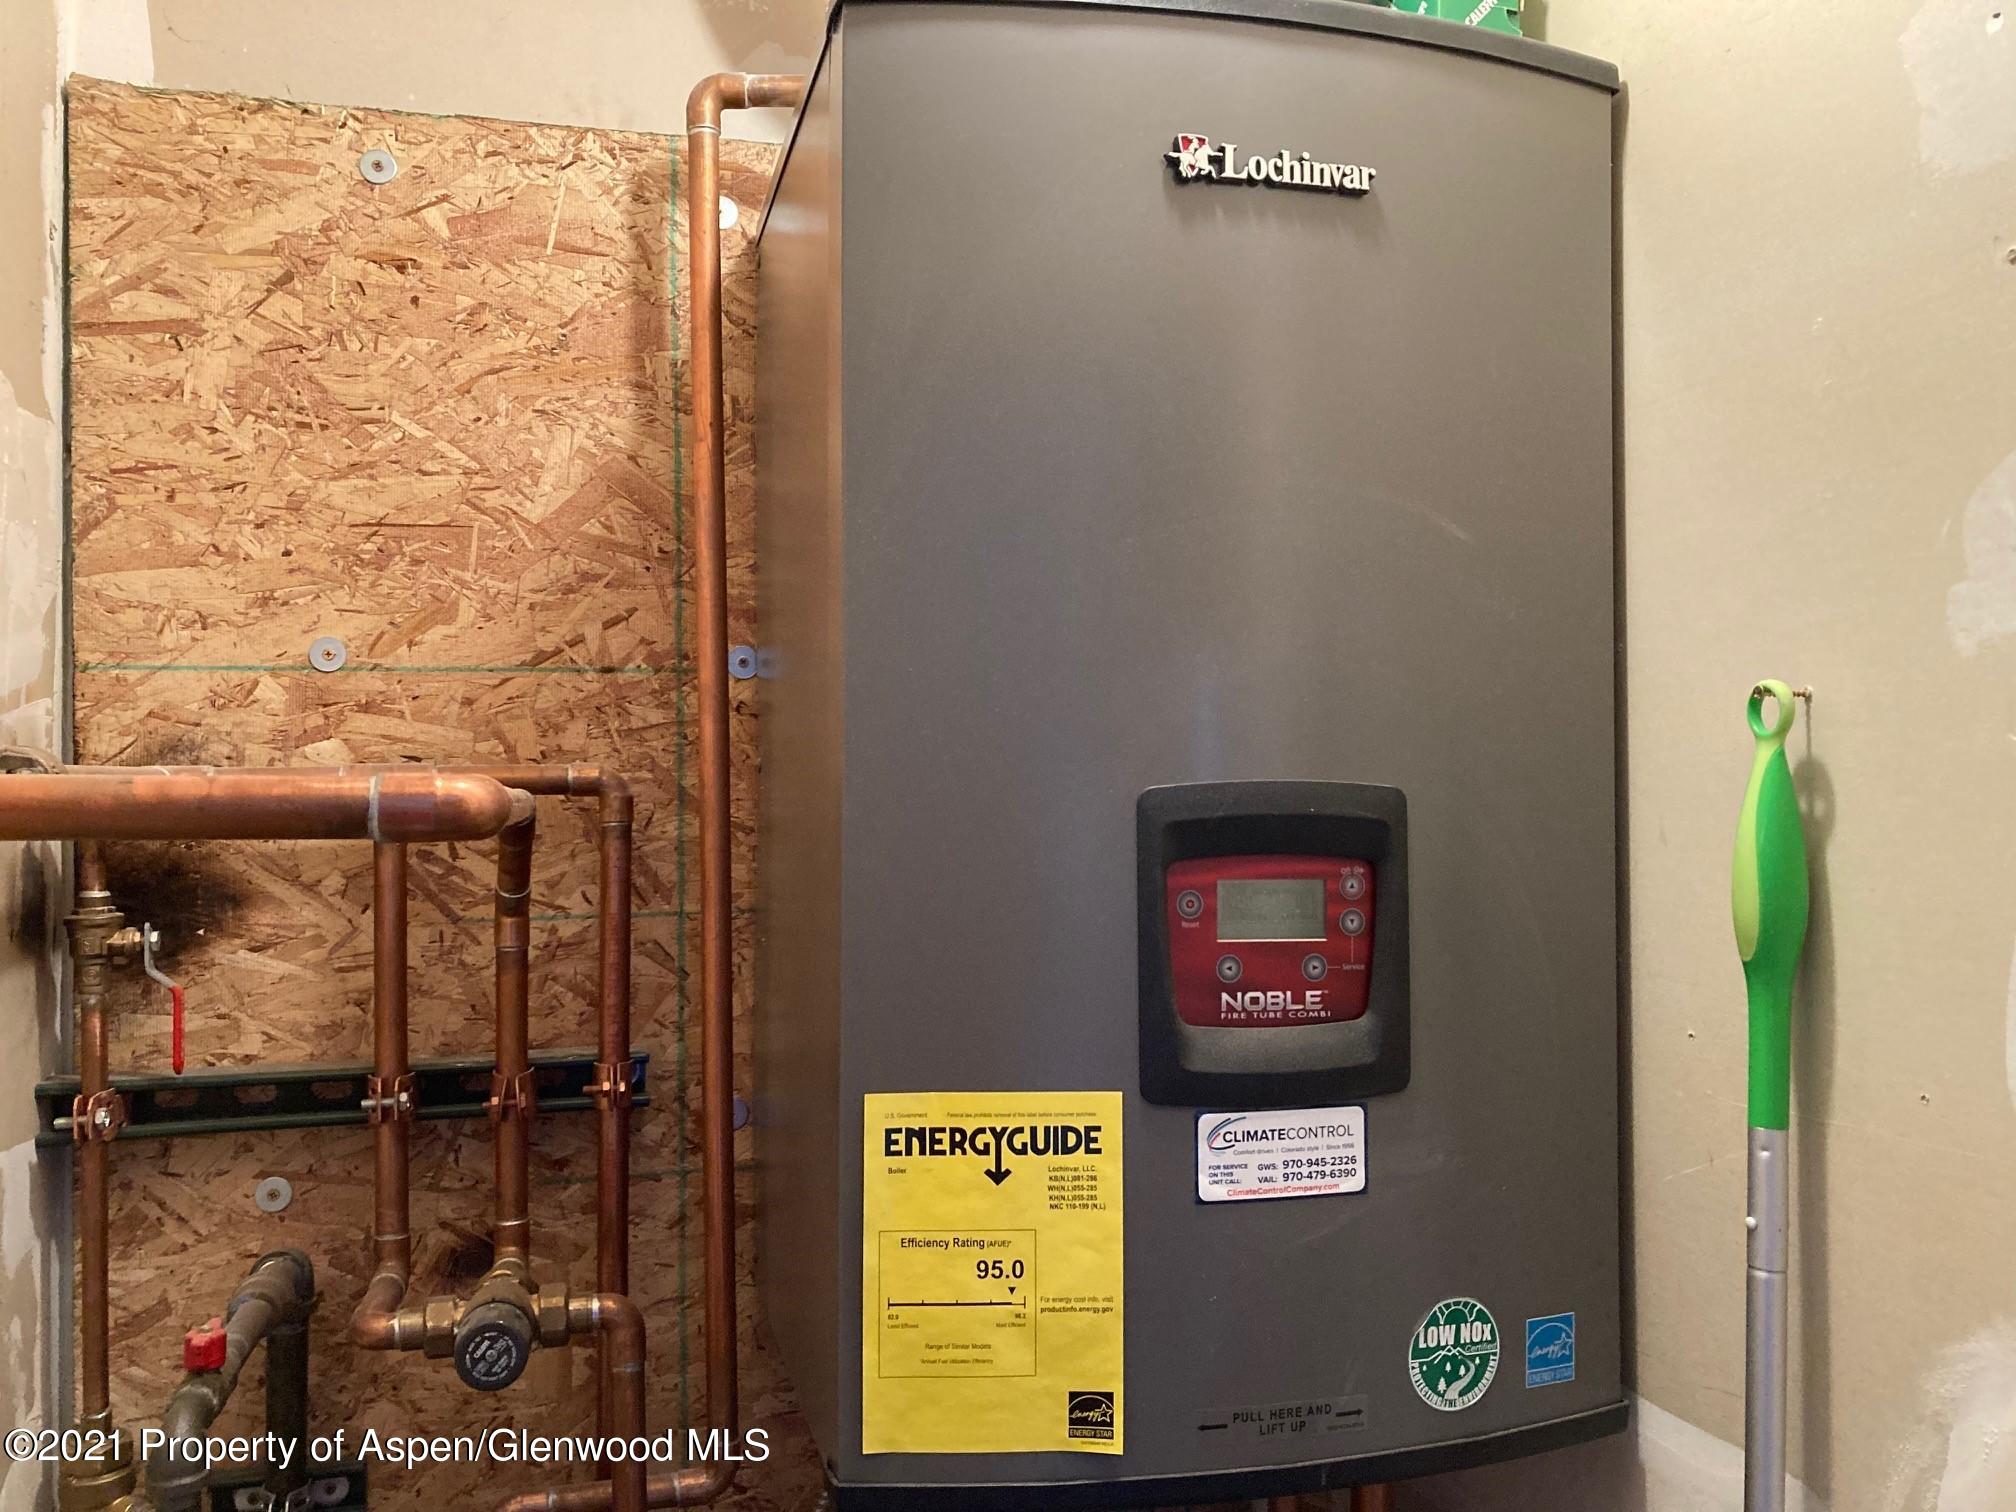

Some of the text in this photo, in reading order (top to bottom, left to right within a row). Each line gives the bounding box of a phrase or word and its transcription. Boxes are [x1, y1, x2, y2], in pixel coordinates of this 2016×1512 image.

[1220, 142, 1376, 190] Lochinvar
[1342, 963, 1365, 971] Service
[1221, 990, 1323, 1011] NOBLE
[1253, 1011, 1282, 1019] TUBE
[1288, 1010, 1331, 1018] COMBI
[884, 1125, 1103, 1156] ENERGYGUIDE
[1223, 1124, 1354, 1143] CLIMATECONTROL
[1326, 1143, 1341, 1151] Since
[1257, 1155, 1357, 1171] GWS: 970-945-2326
[888, 1167, 906, 1175] Boiler
[1257, 1168, 1357, 1184] VAIL: 970-479-6390
[1227, 1182, 1340, 1197] ClimateControlCompany.com
[901, 1237, 949, 1250] Efficiency
[953, 1237, 985, 1250] Rating
[976, 1259, 1024, 1280] 95.0
[1052, 1296, 1072, 1304] energy
[1418, 1324, 1456, 1348] LOW
[925, 1342, 944, 1352] Range
[1465, 1342, 1497, 1353] Certified
[1410, 1354, 1497, 1409] PROTECTING THE ENVIRONMENT
[1233, 1404, 1332, 1424] PULL HERE AND
[1070, 1429, 1113, 1438] ENERGY STAR
[1259, 1421, 1306, 1435] LIFT UP
